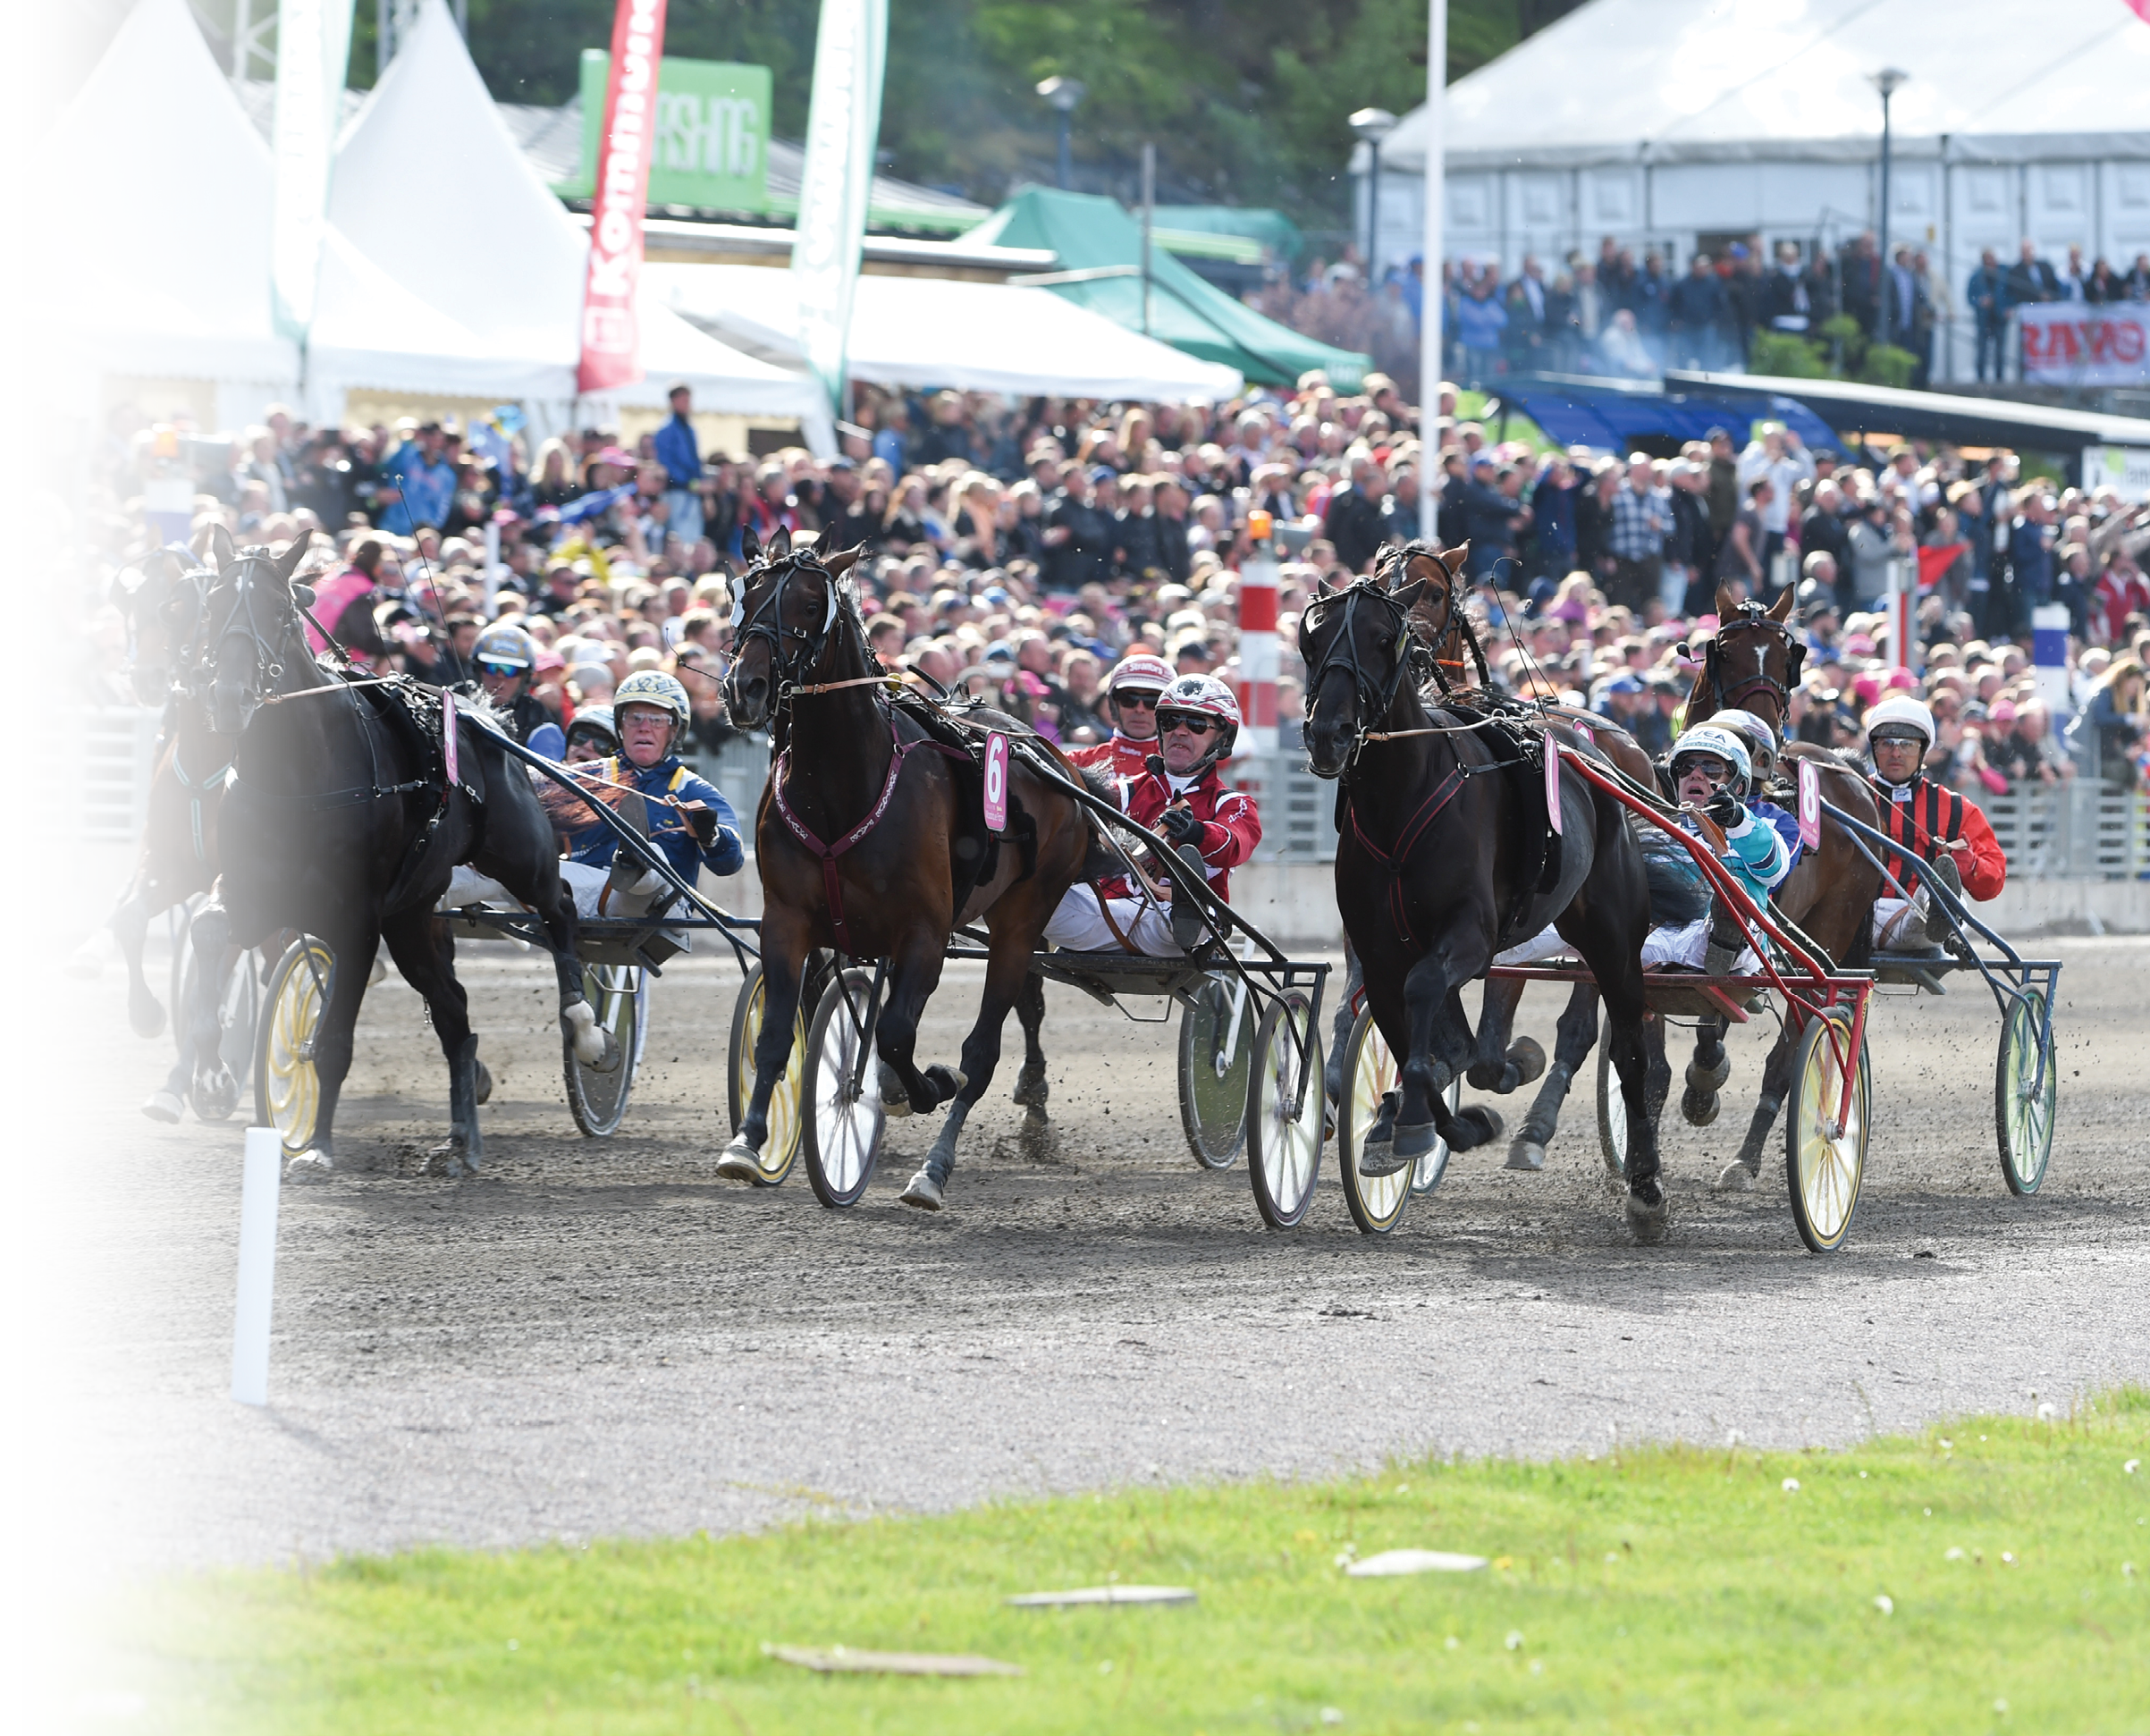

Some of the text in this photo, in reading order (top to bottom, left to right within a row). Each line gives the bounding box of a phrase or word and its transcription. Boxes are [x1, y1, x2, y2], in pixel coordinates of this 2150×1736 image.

[589, 0, 657, 296] Kommun
[445, 695, 454, 758] 4
[987, 736, 1003, 804] 6
[1548, 737, 1555, 804] 1
[1802, 763, 1817, 824] 8
